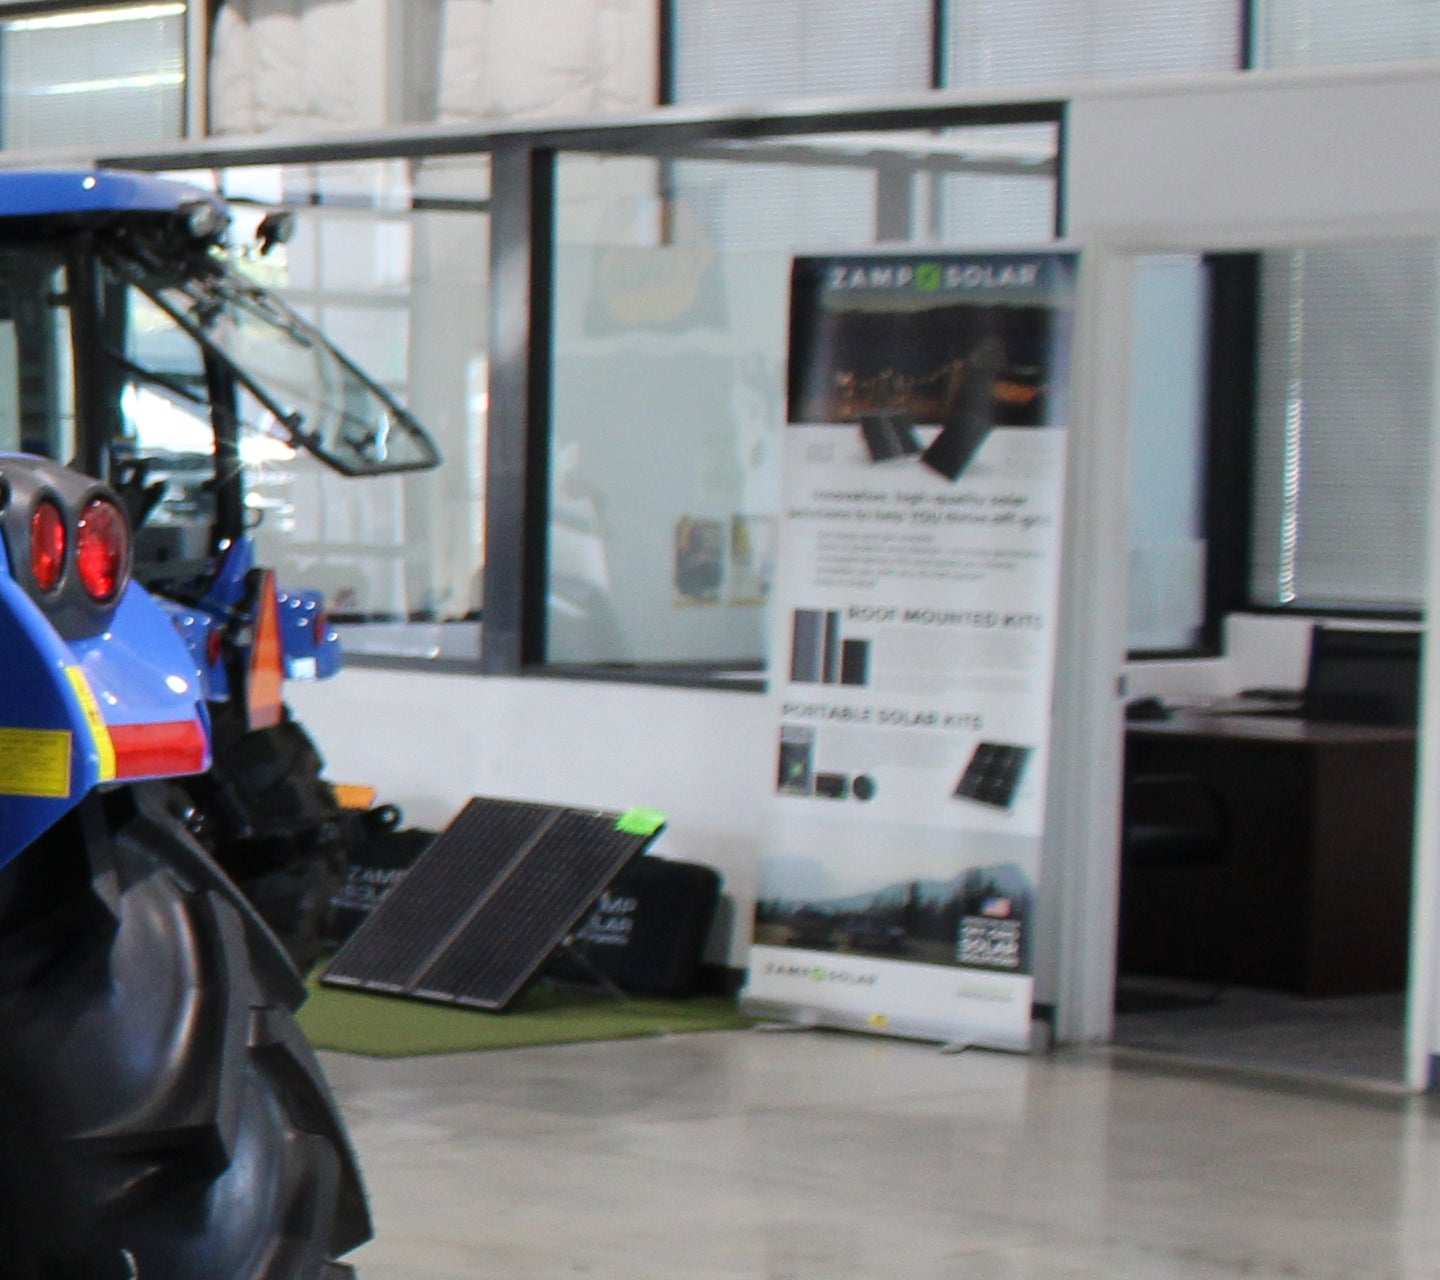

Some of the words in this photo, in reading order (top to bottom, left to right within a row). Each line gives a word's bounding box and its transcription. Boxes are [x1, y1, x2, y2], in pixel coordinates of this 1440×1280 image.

[831, 265, 914, 290] ZAMP
[943, 264, 1037, 289] SOLAR
[878, 707, 937, 726] SOLAR
